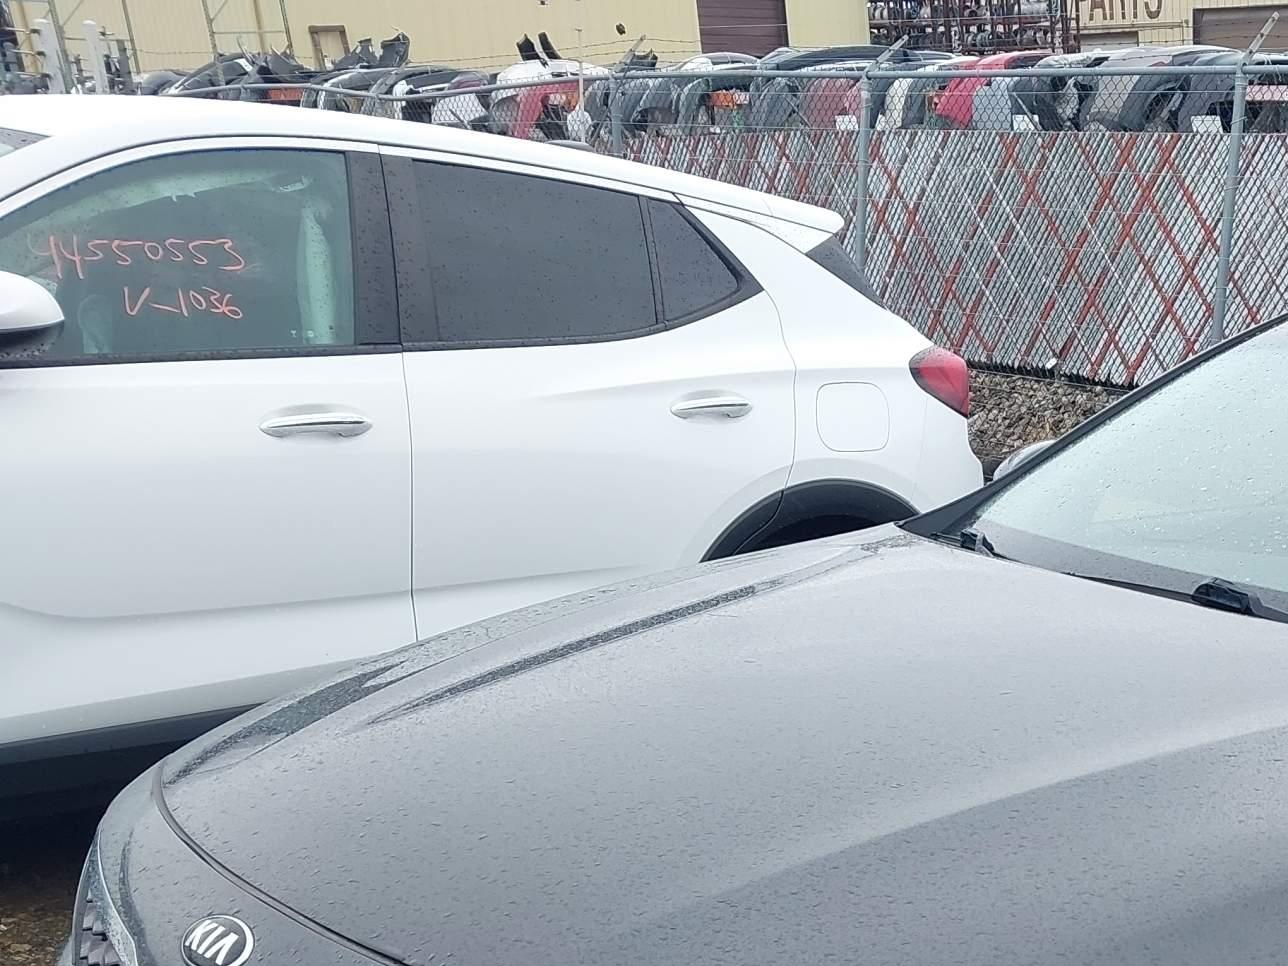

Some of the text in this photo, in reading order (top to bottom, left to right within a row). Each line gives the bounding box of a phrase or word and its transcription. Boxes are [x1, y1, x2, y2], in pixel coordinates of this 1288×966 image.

[1079, 0, 1163, 20] ARTS
[27, 233, 246, 280] 44550553
[184, 919, 240, 966] KIA
